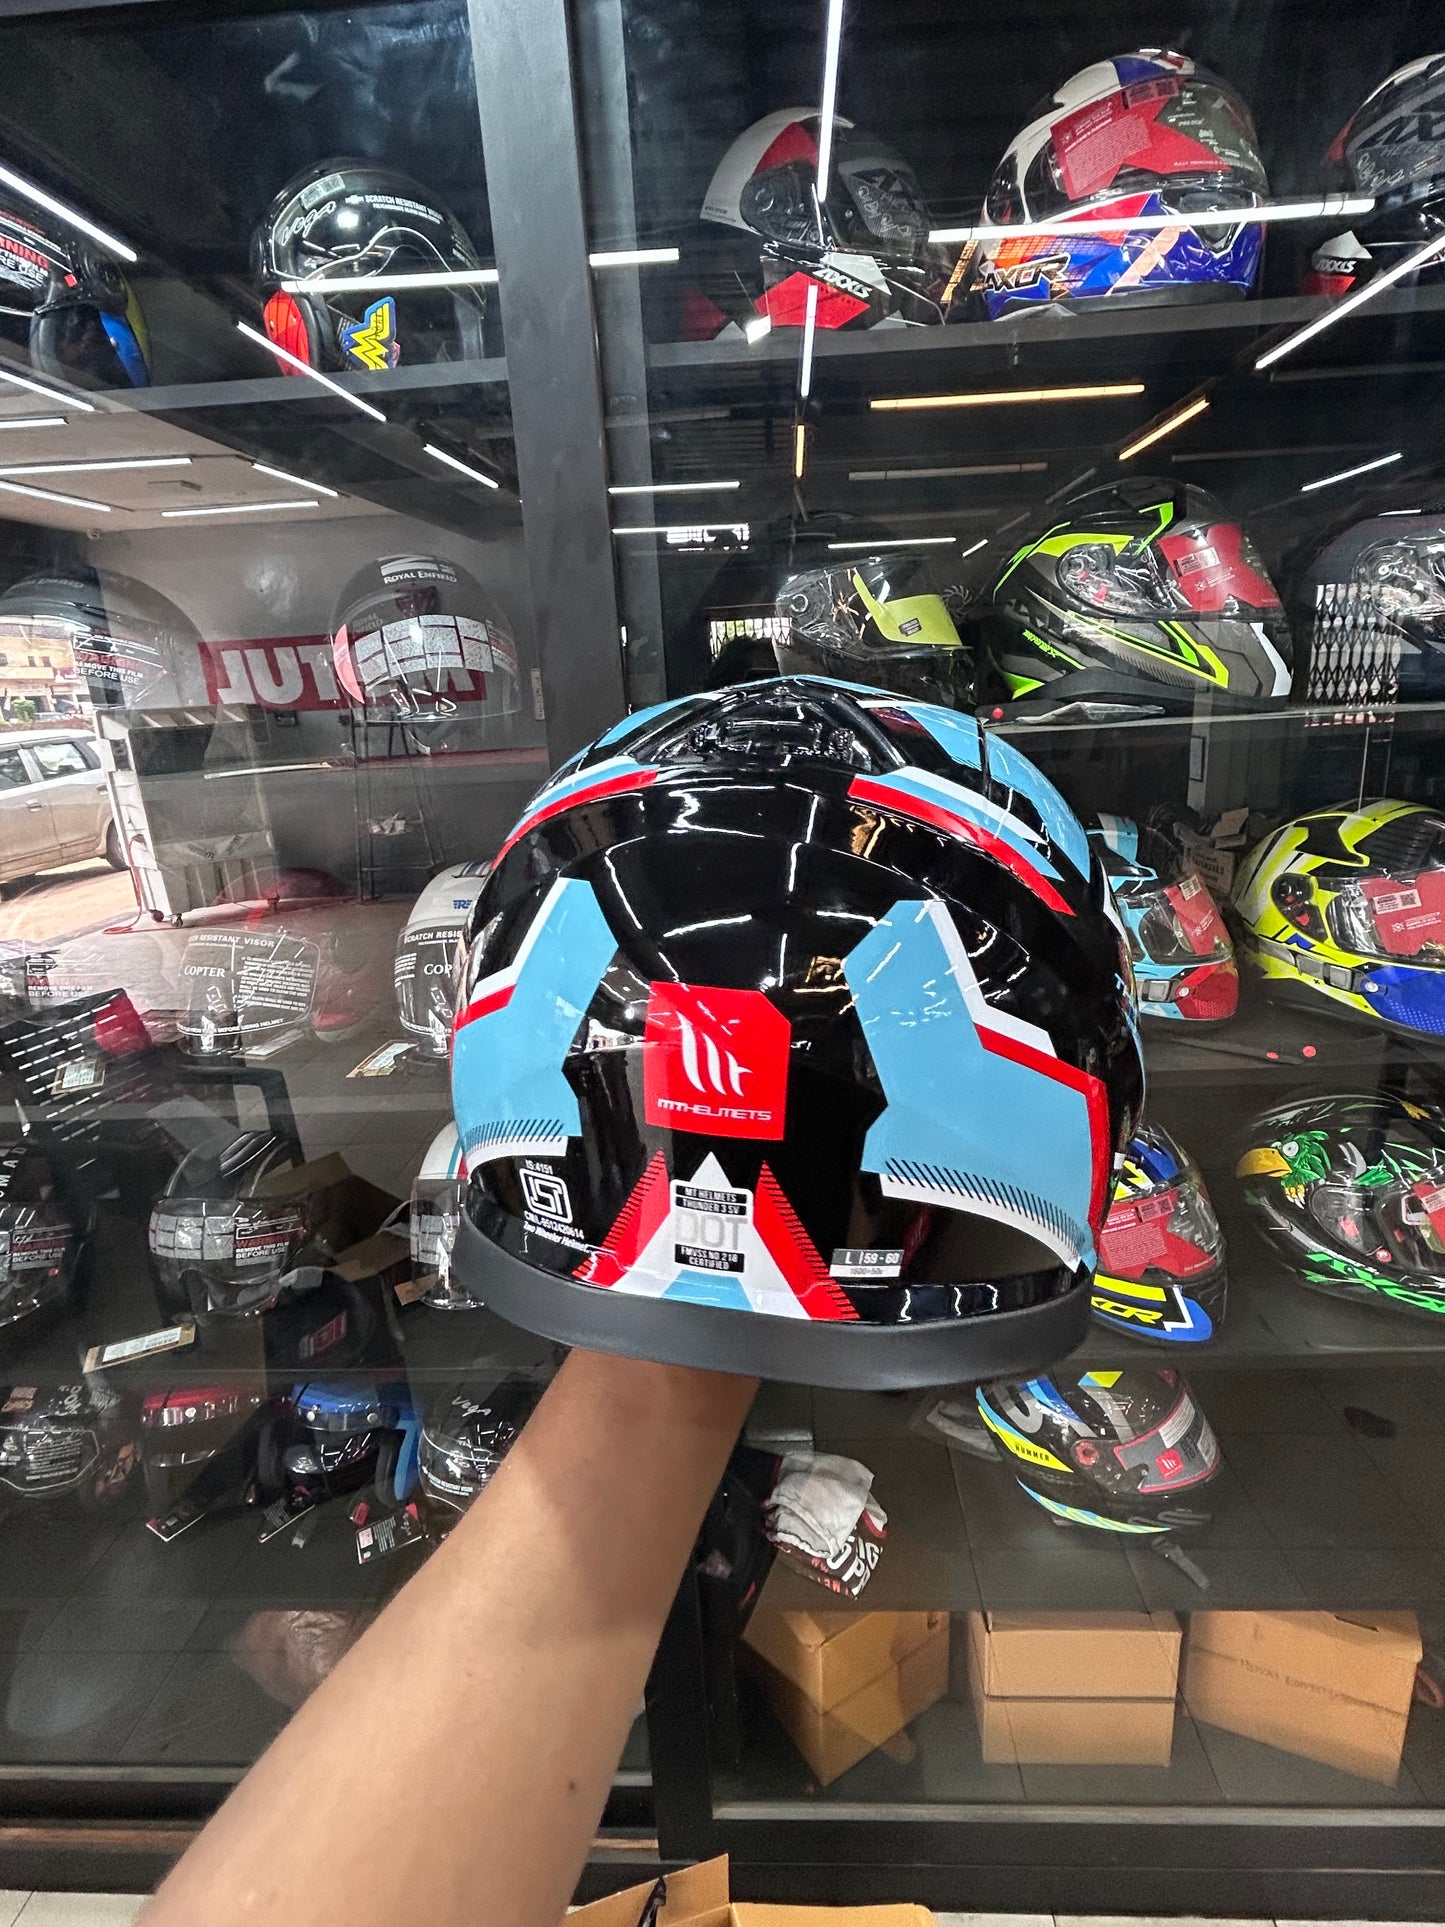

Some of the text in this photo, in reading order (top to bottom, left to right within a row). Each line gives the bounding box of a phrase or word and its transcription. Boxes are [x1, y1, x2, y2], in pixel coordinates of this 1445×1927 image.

[0, 236, 49, 270] NING
[18, 262, 44, 281] USE
[980, 253, 1071, 293] AXOR
[1316, 259, 1357, 273] AXXIS
[812, 267, 872, 298] AXXIS
[384, 570, 458, 584] ROYAL ENFIELD
[73, 667, 140, 685] BEFORE USE
[436, 930, 463, 938] RESIS
[244, 938, 275, 948] VISOR
[184, 965, 226, 978] COPTER
[424, 963, 453, 976] COP
[698, 1189, 737, 1203] HELMETS
[682, 1198, 720, 1213] THUNDER
[720, 1203, 727, 1212] 3
[676, 1210, 748, 1251] DOT
[236, 1249, 270, 1259] BEFORE
[845, 1251, 853, 1264] L
[688, 1256, 730, 1270] CERTIFIED
